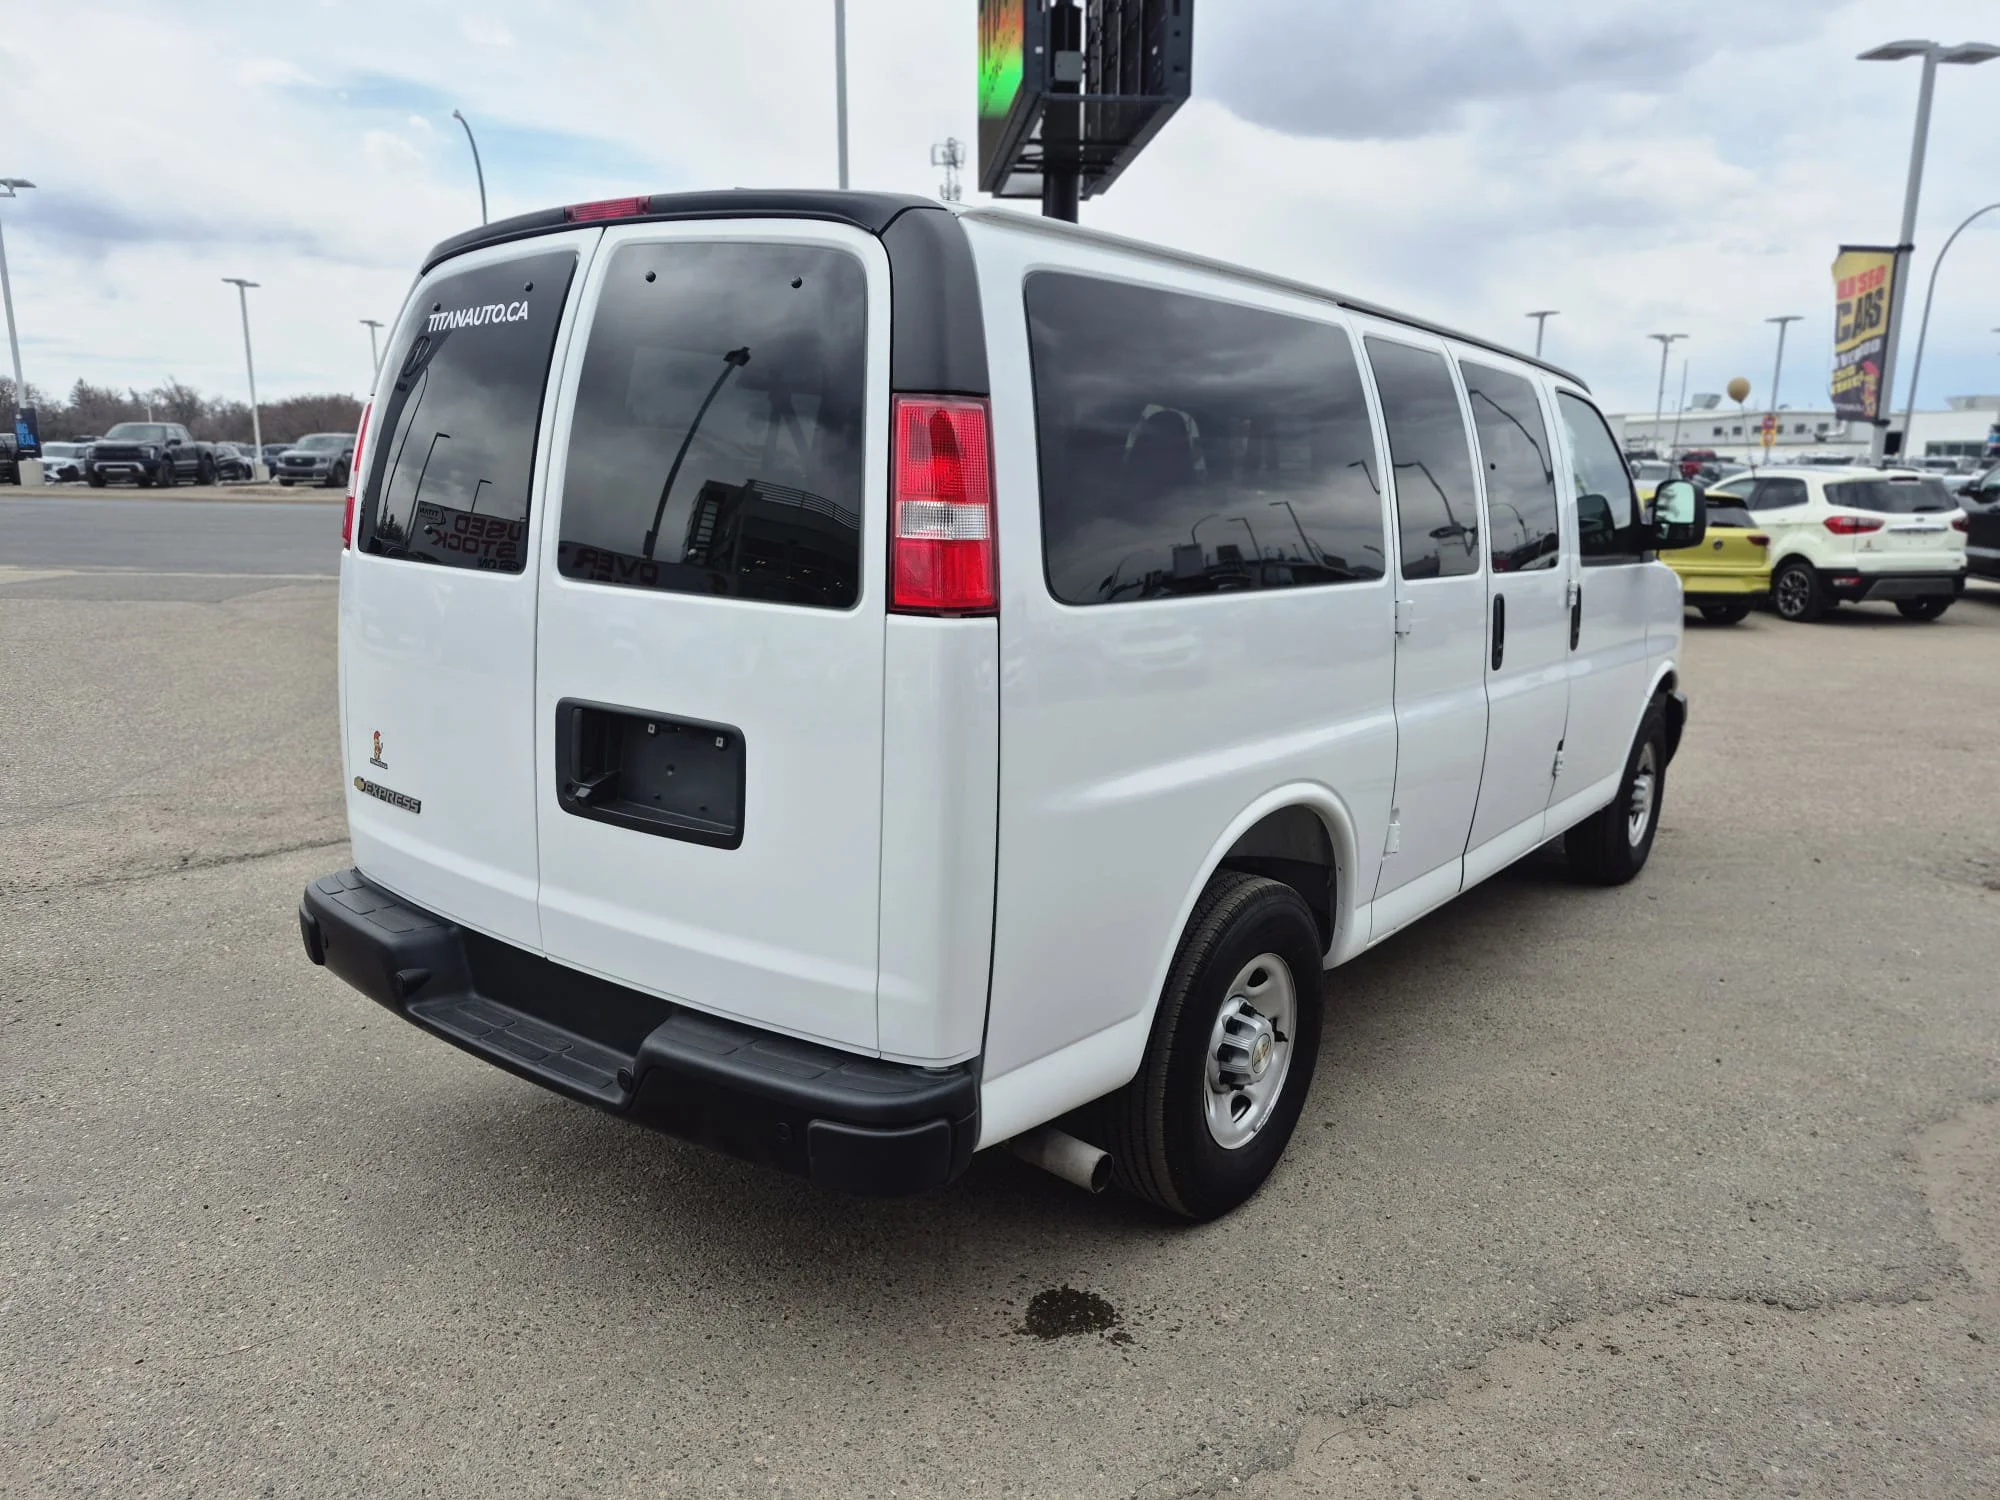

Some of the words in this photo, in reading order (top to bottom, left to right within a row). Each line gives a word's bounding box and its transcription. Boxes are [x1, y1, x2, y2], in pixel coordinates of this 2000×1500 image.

[1836, 265, 1886, 299] USED
[427, 300, 528, 333] TITANAUTO.CA
[1835, 287, 1884, 345] CARS
[364, 781, 421, 814] EXPRESS
